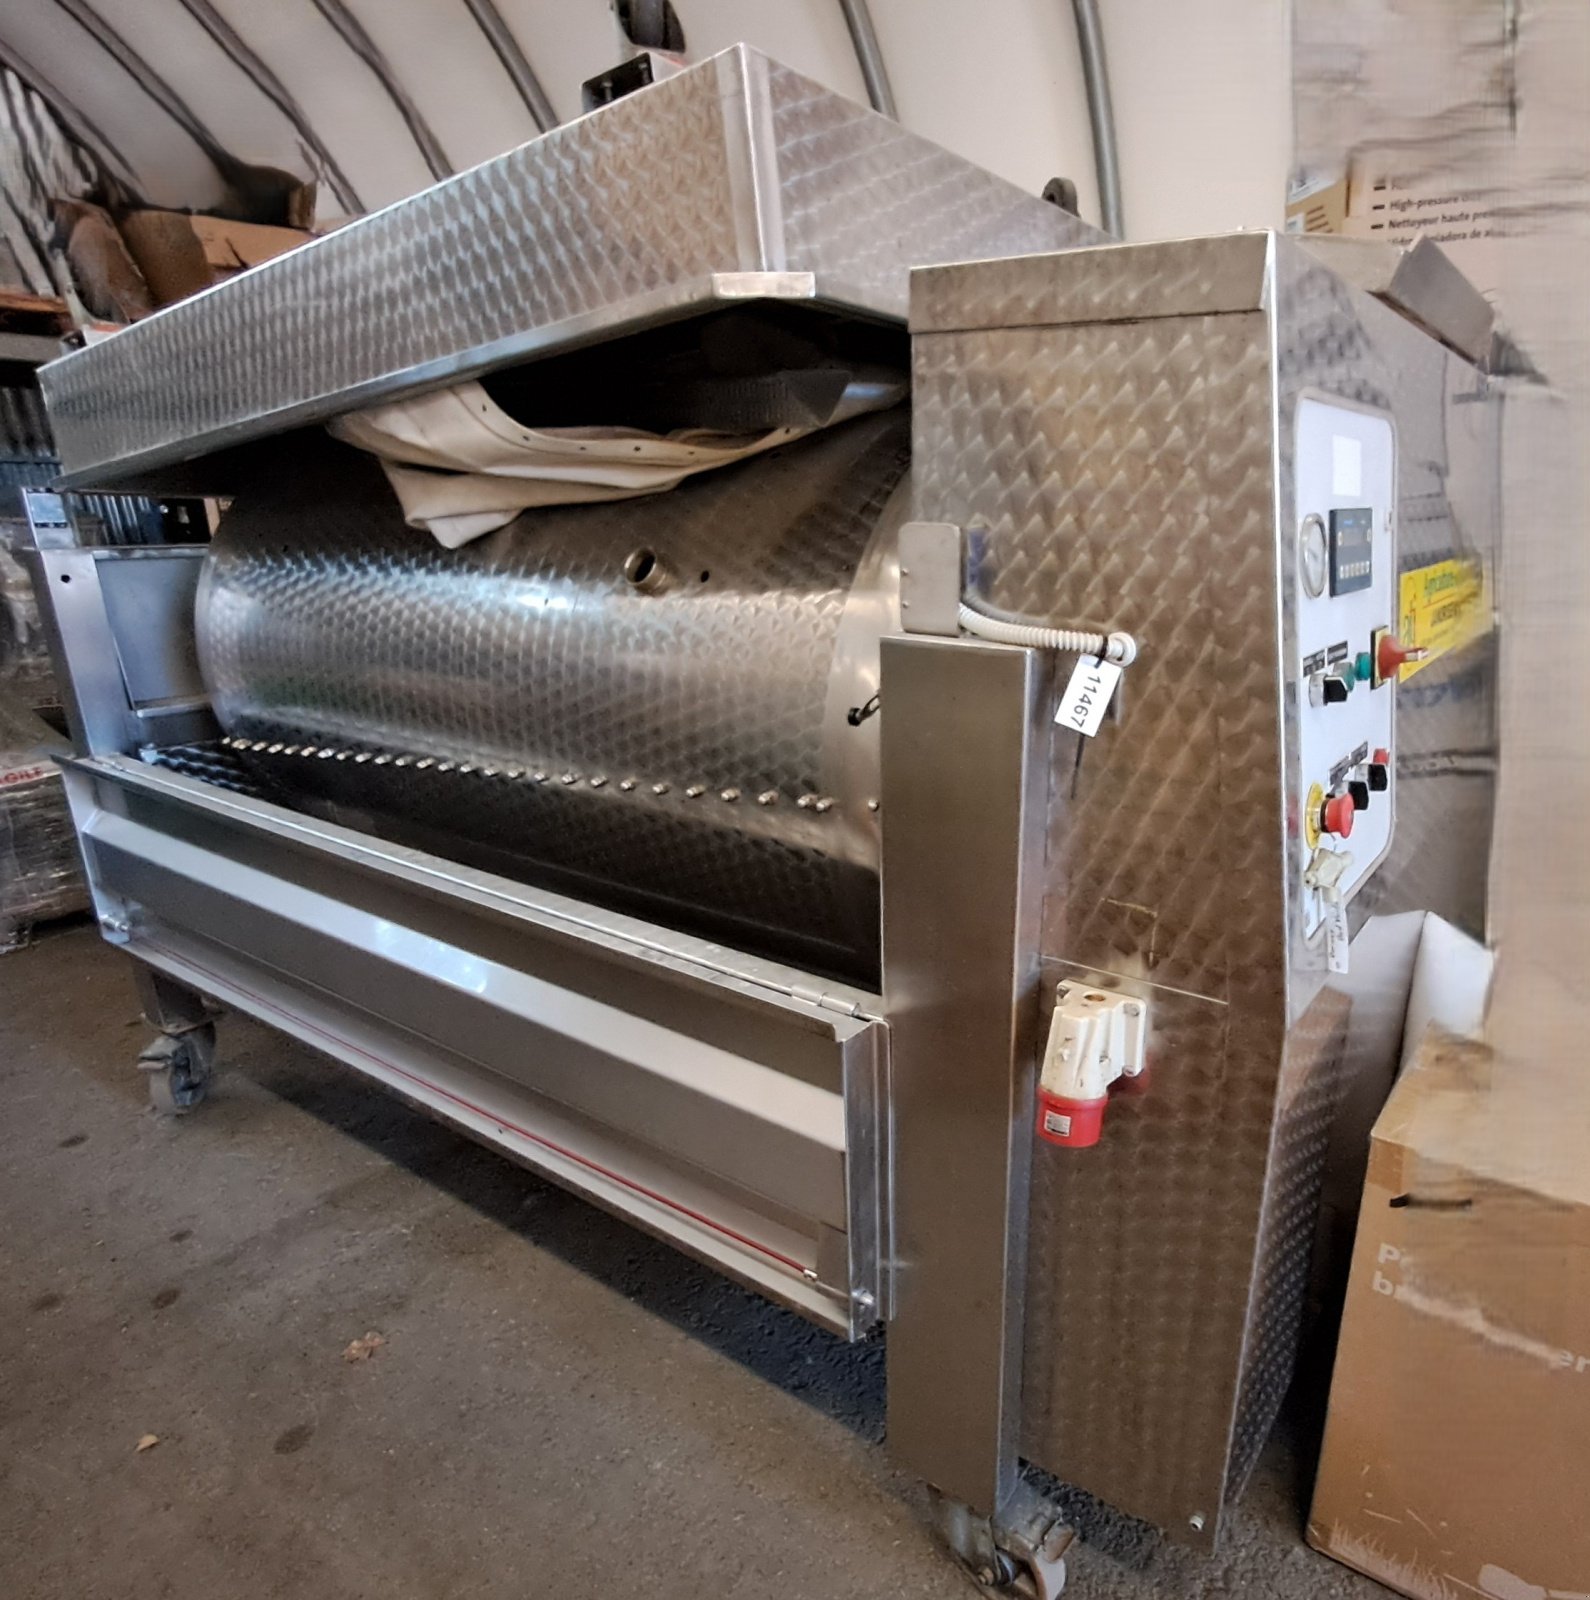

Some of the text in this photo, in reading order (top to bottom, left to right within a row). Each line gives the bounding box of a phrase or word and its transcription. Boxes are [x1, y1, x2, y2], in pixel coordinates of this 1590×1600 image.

[1388, 216, 1440, 230] Nettoyeur
[1441, 211, 1470, 223] haute
[1070, 676, 1101, 728] 11467
